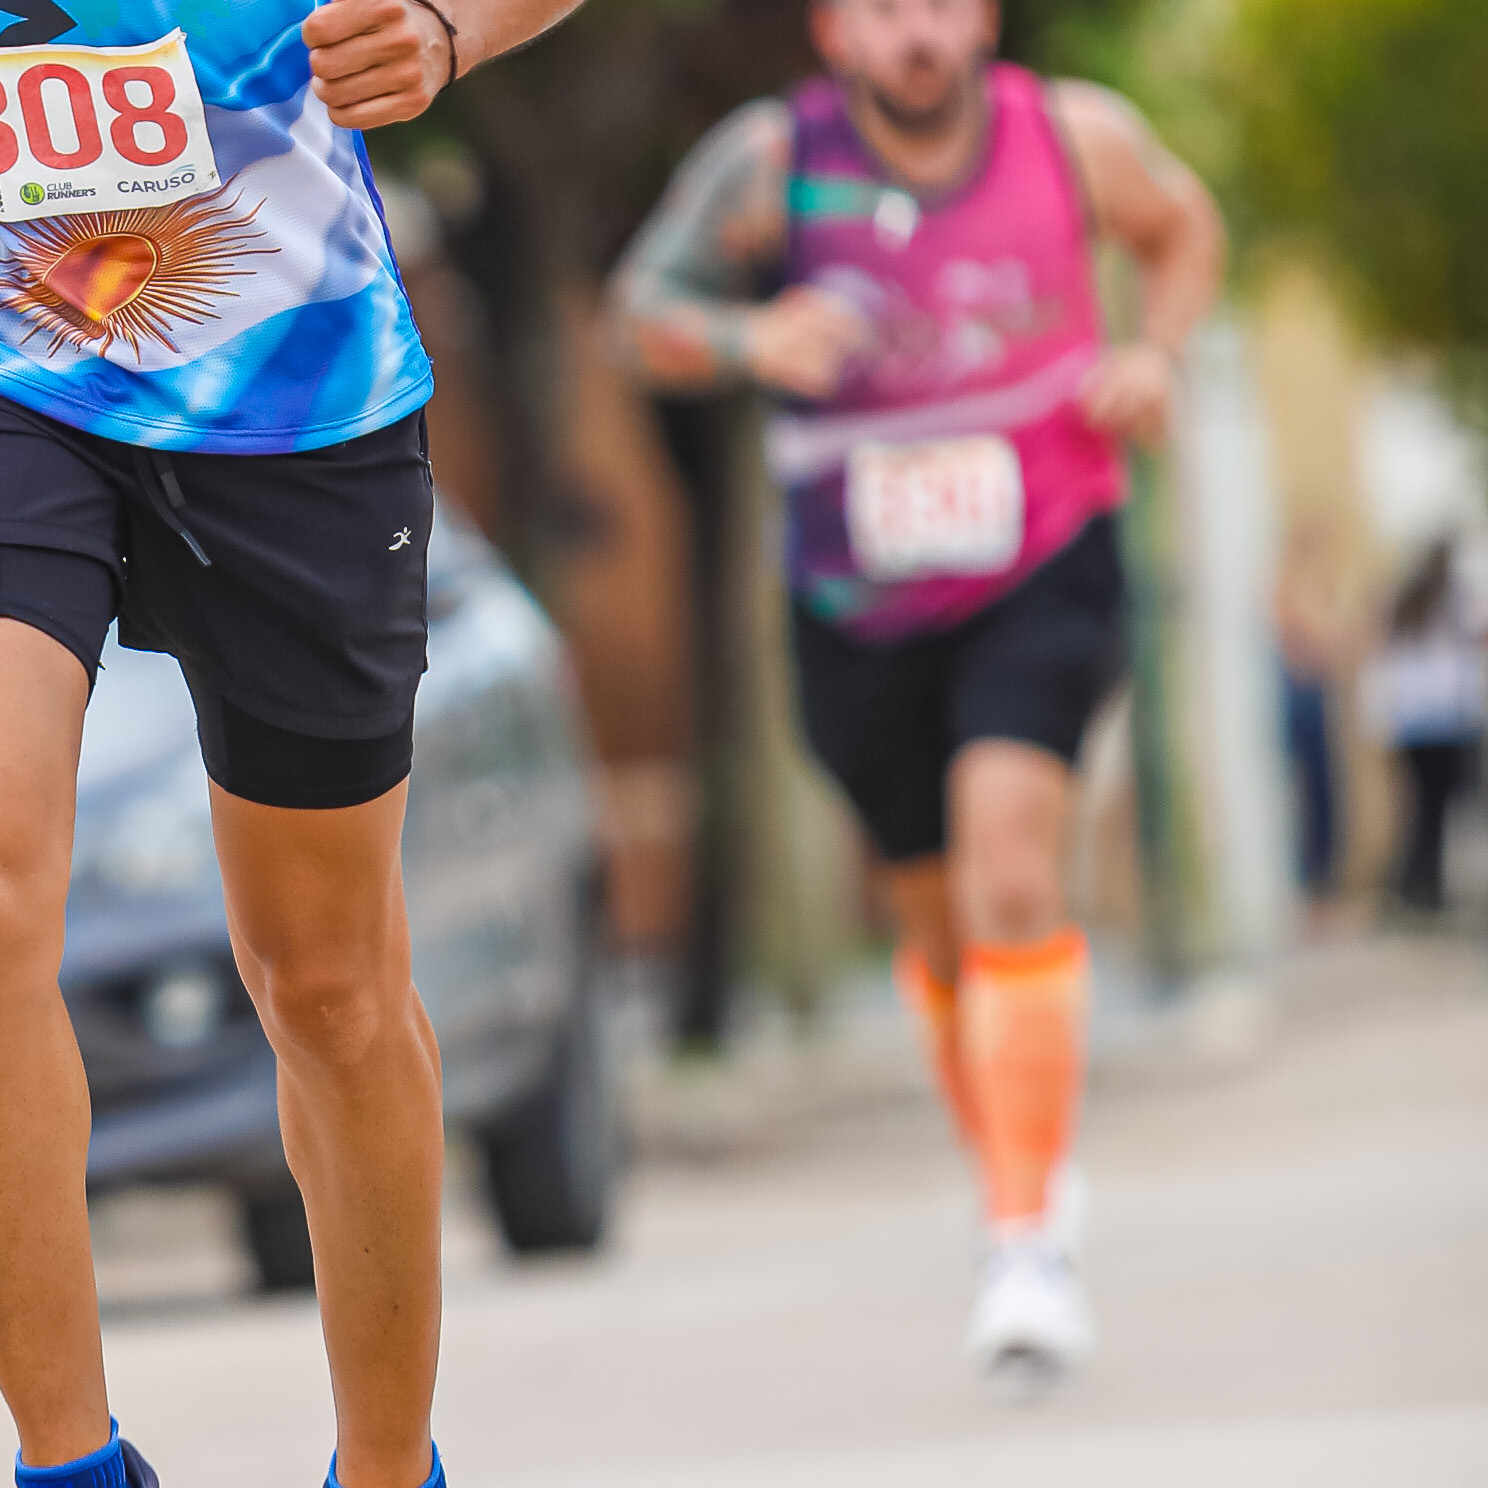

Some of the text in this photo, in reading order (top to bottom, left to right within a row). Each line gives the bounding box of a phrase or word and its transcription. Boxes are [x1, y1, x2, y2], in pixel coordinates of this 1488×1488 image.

[47, 182, 73, 191] CLUB
[117, 172, 195, 193] CARUSO
[47, 188, 96, 200] RUNNER'S
